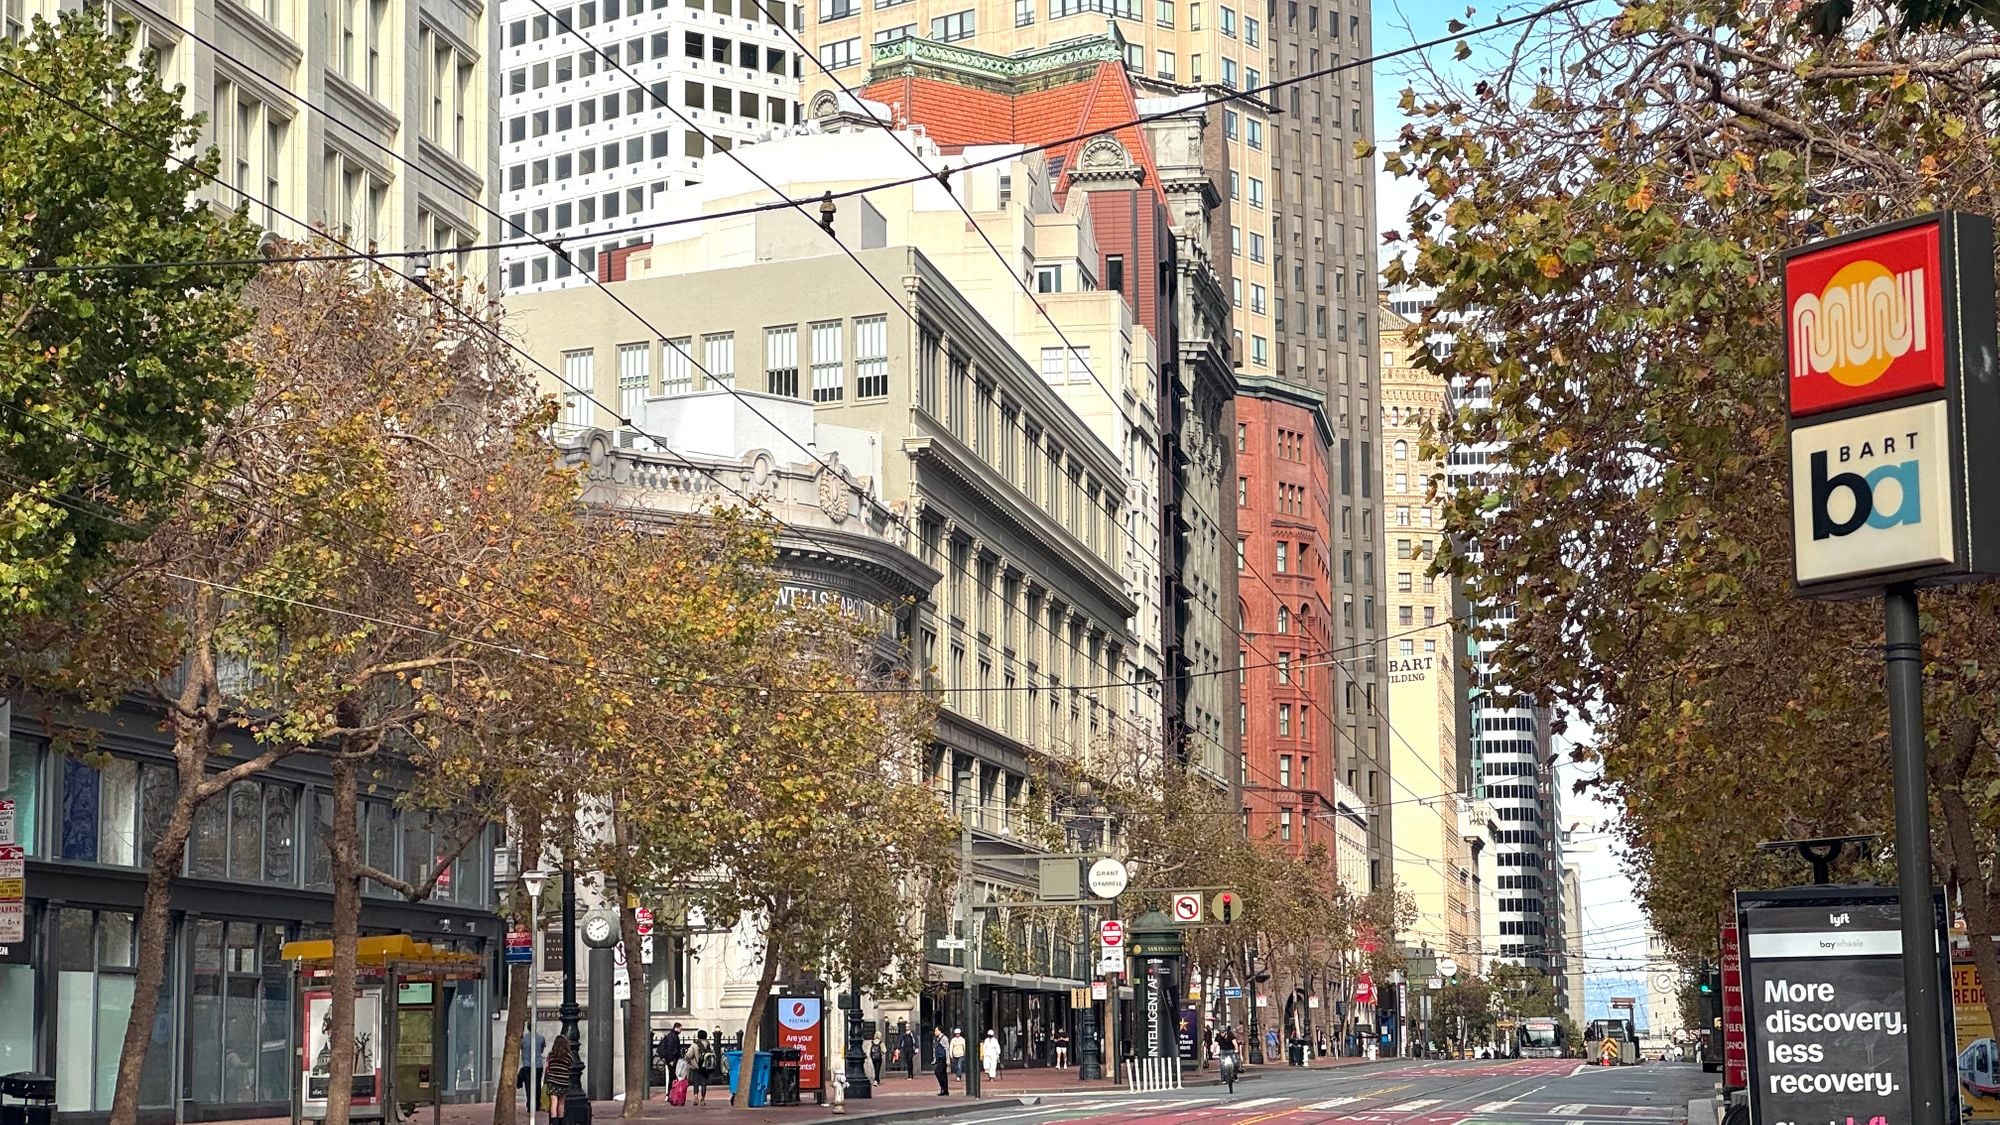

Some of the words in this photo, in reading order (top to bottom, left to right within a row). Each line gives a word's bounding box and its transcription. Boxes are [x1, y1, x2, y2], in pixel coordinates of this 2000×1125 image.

[1839, 432, 1919, 463] BART
[1387, 673, 1425, 684] ILDING
[1830, 914, 1850, 927] lyft
[1147, 975, 1159, 989] AF
[1764, 980, 1835, 1003] More
[1147, 990, 1159, 1058] INTELLIGENT
[1765, 1009, 1908, 1035] discovery,
[798, 1035, 813, 1043] your
[1768, 1040, 1824, 1064] less
[1770, 1072, 1900, 1096] recovery.
